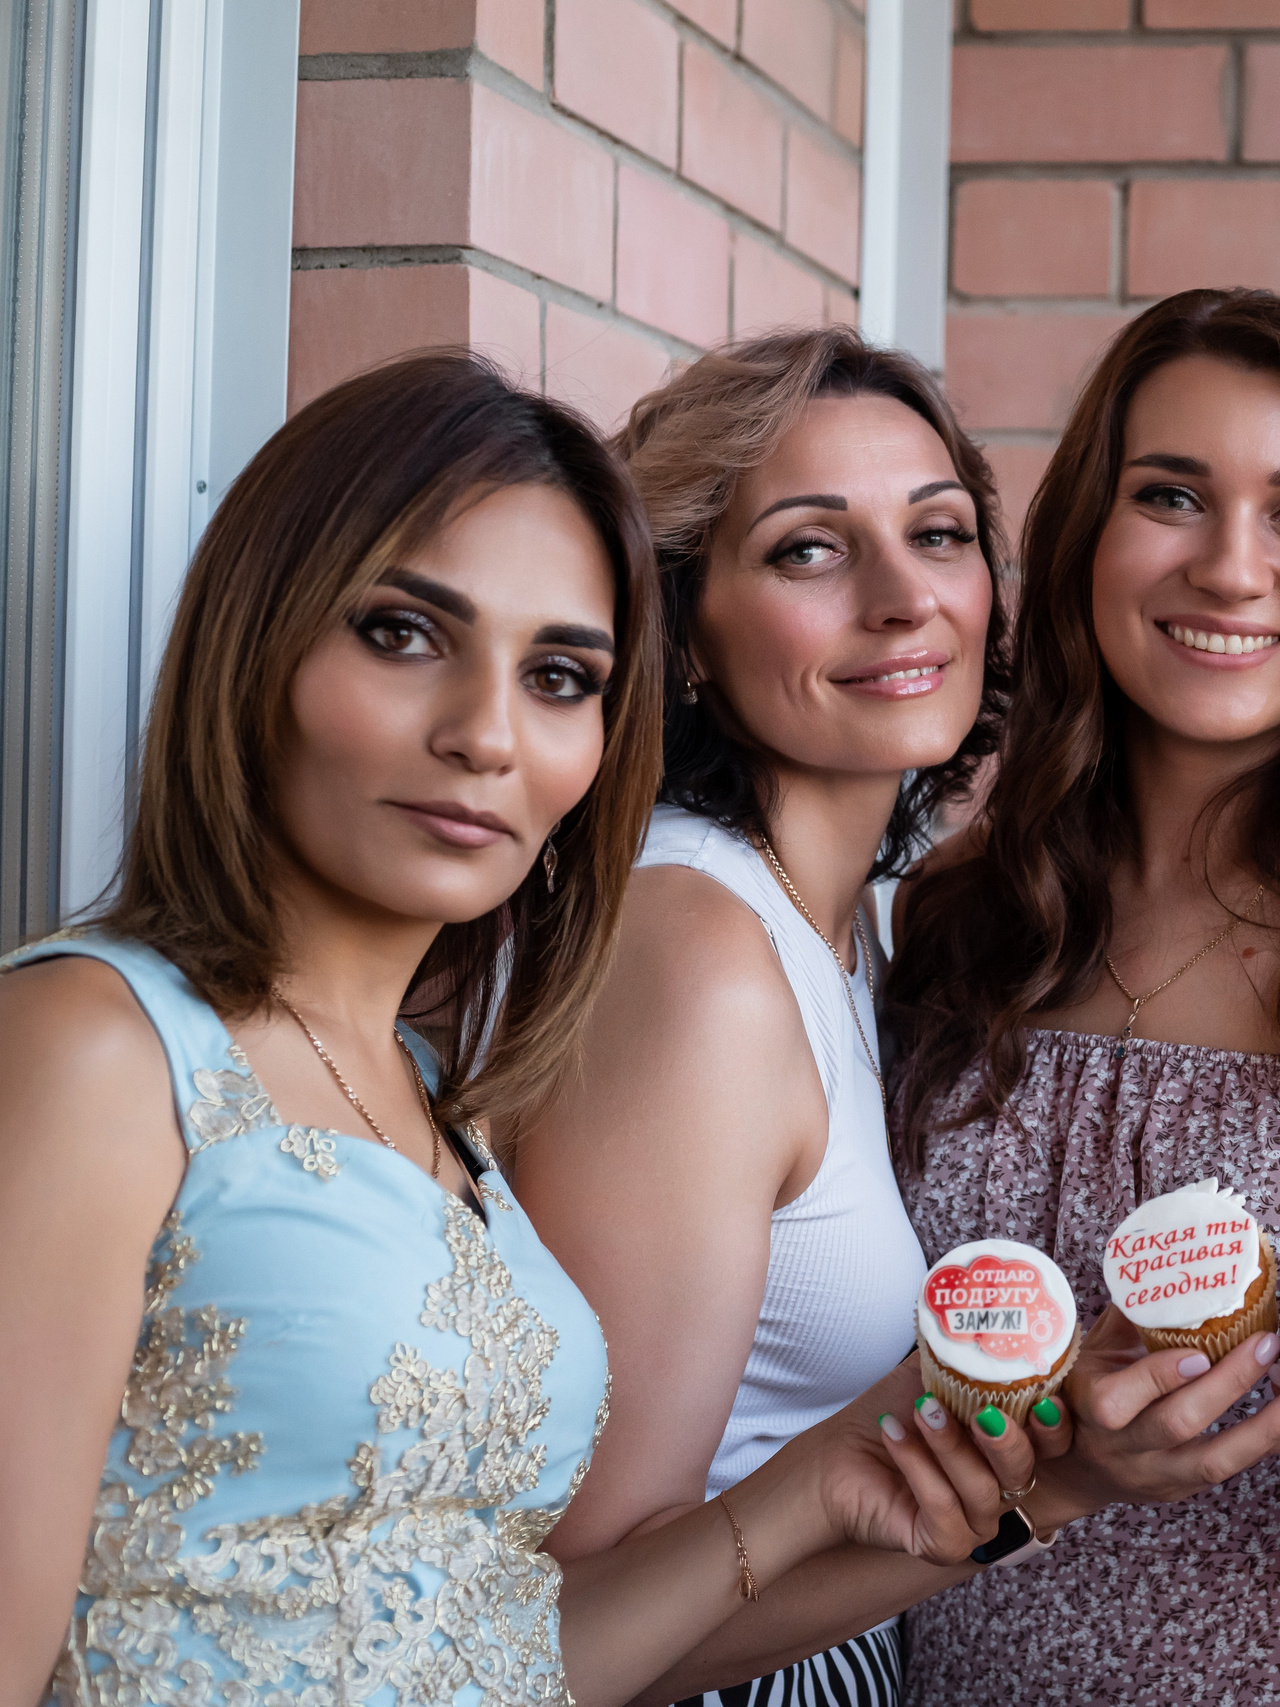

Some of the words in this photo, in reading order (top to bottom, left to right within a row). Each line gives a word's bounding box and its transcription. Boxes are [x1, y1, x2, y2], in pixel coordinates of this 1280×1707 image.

[1108, 1226, 1196, 1259] Какая
[1206, 1218, 1251, 1236] ты
[972, 1269, 1035, 1284] ОТДАЮ
[1118, 1240, 1243, 1284] красивая
[934, 1287, 1040, 1307] ПОДРУГУ
[1125, 1264, 1237, 1308] сегодня!
[954, 1310, 1022, 1331] ЗАМУЖ!
